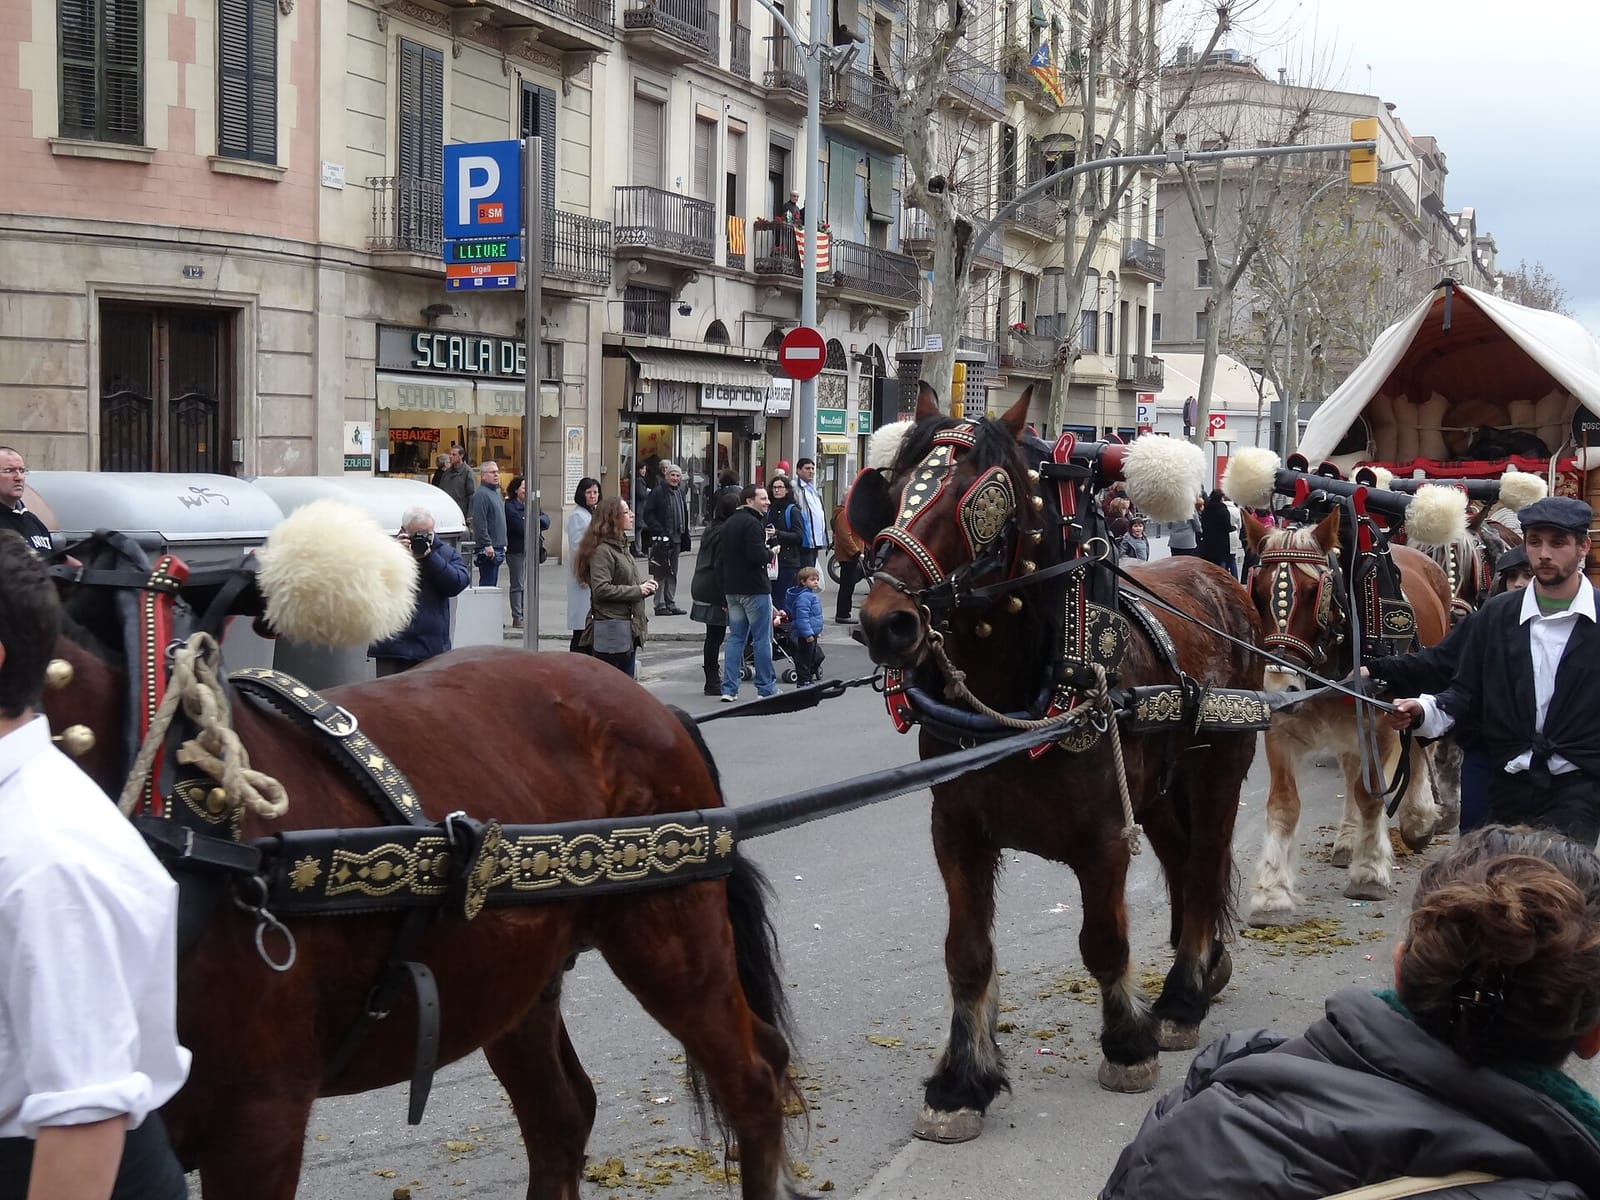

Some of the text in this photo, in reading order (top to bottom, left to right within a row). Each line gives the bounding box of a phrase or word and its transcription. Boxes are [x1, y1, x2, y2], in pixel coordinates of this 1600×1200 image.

[459, 156, 500, 225] P
[189, 267, 200, 277] 12
[471, 264, 491, 275] Urgell
[416, 333, 492, 372] SCALA
[398, 384, 436, 408] SCALA
[705, 385, 715, 400] el
[635, 394, 643, 406] 10
[1137, 406, 1147, 422] P
[389, 429, 440, 442] REBAIXES
[344, 457, 362, 467] SCALA
[362, 458, 371, 467] DEI
